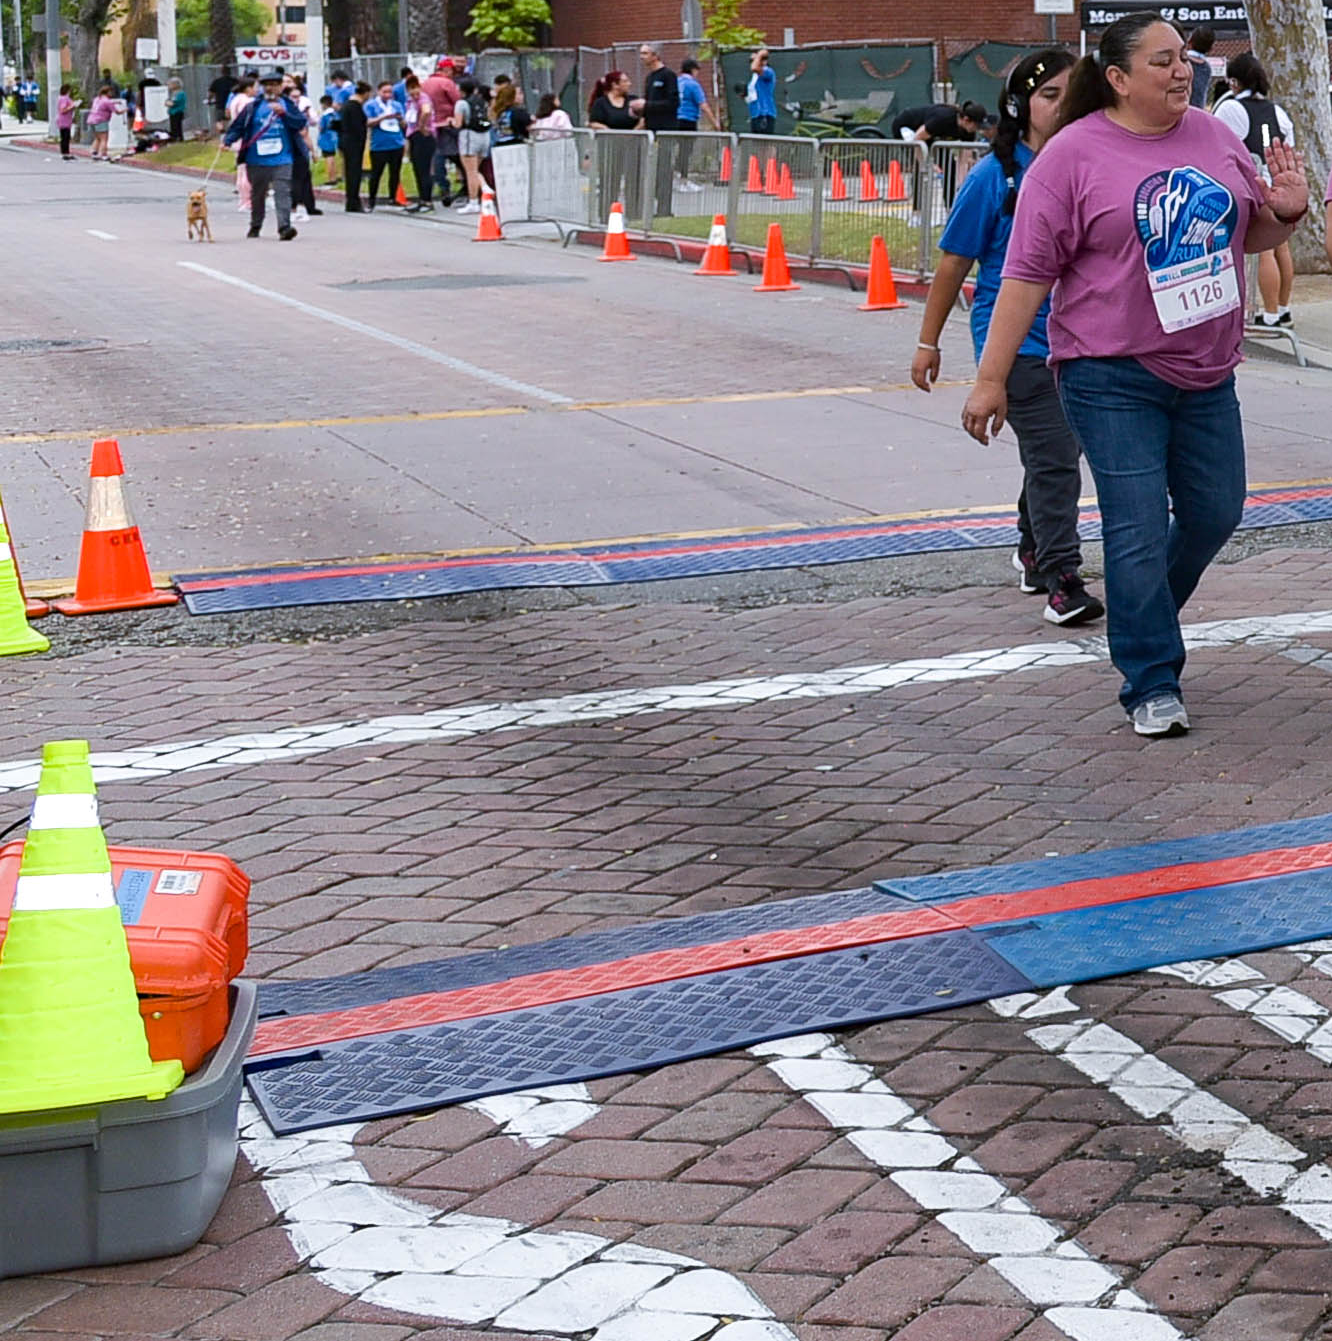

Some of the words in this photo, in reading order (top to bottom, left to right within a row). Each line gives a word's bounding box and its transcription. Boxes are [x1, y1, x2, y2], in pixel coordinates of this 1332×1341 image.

[1178, 7, 1210, 21] Son
[258, 49, 291, 60] CVS
[1178, 280, 1224, 311] 1126
